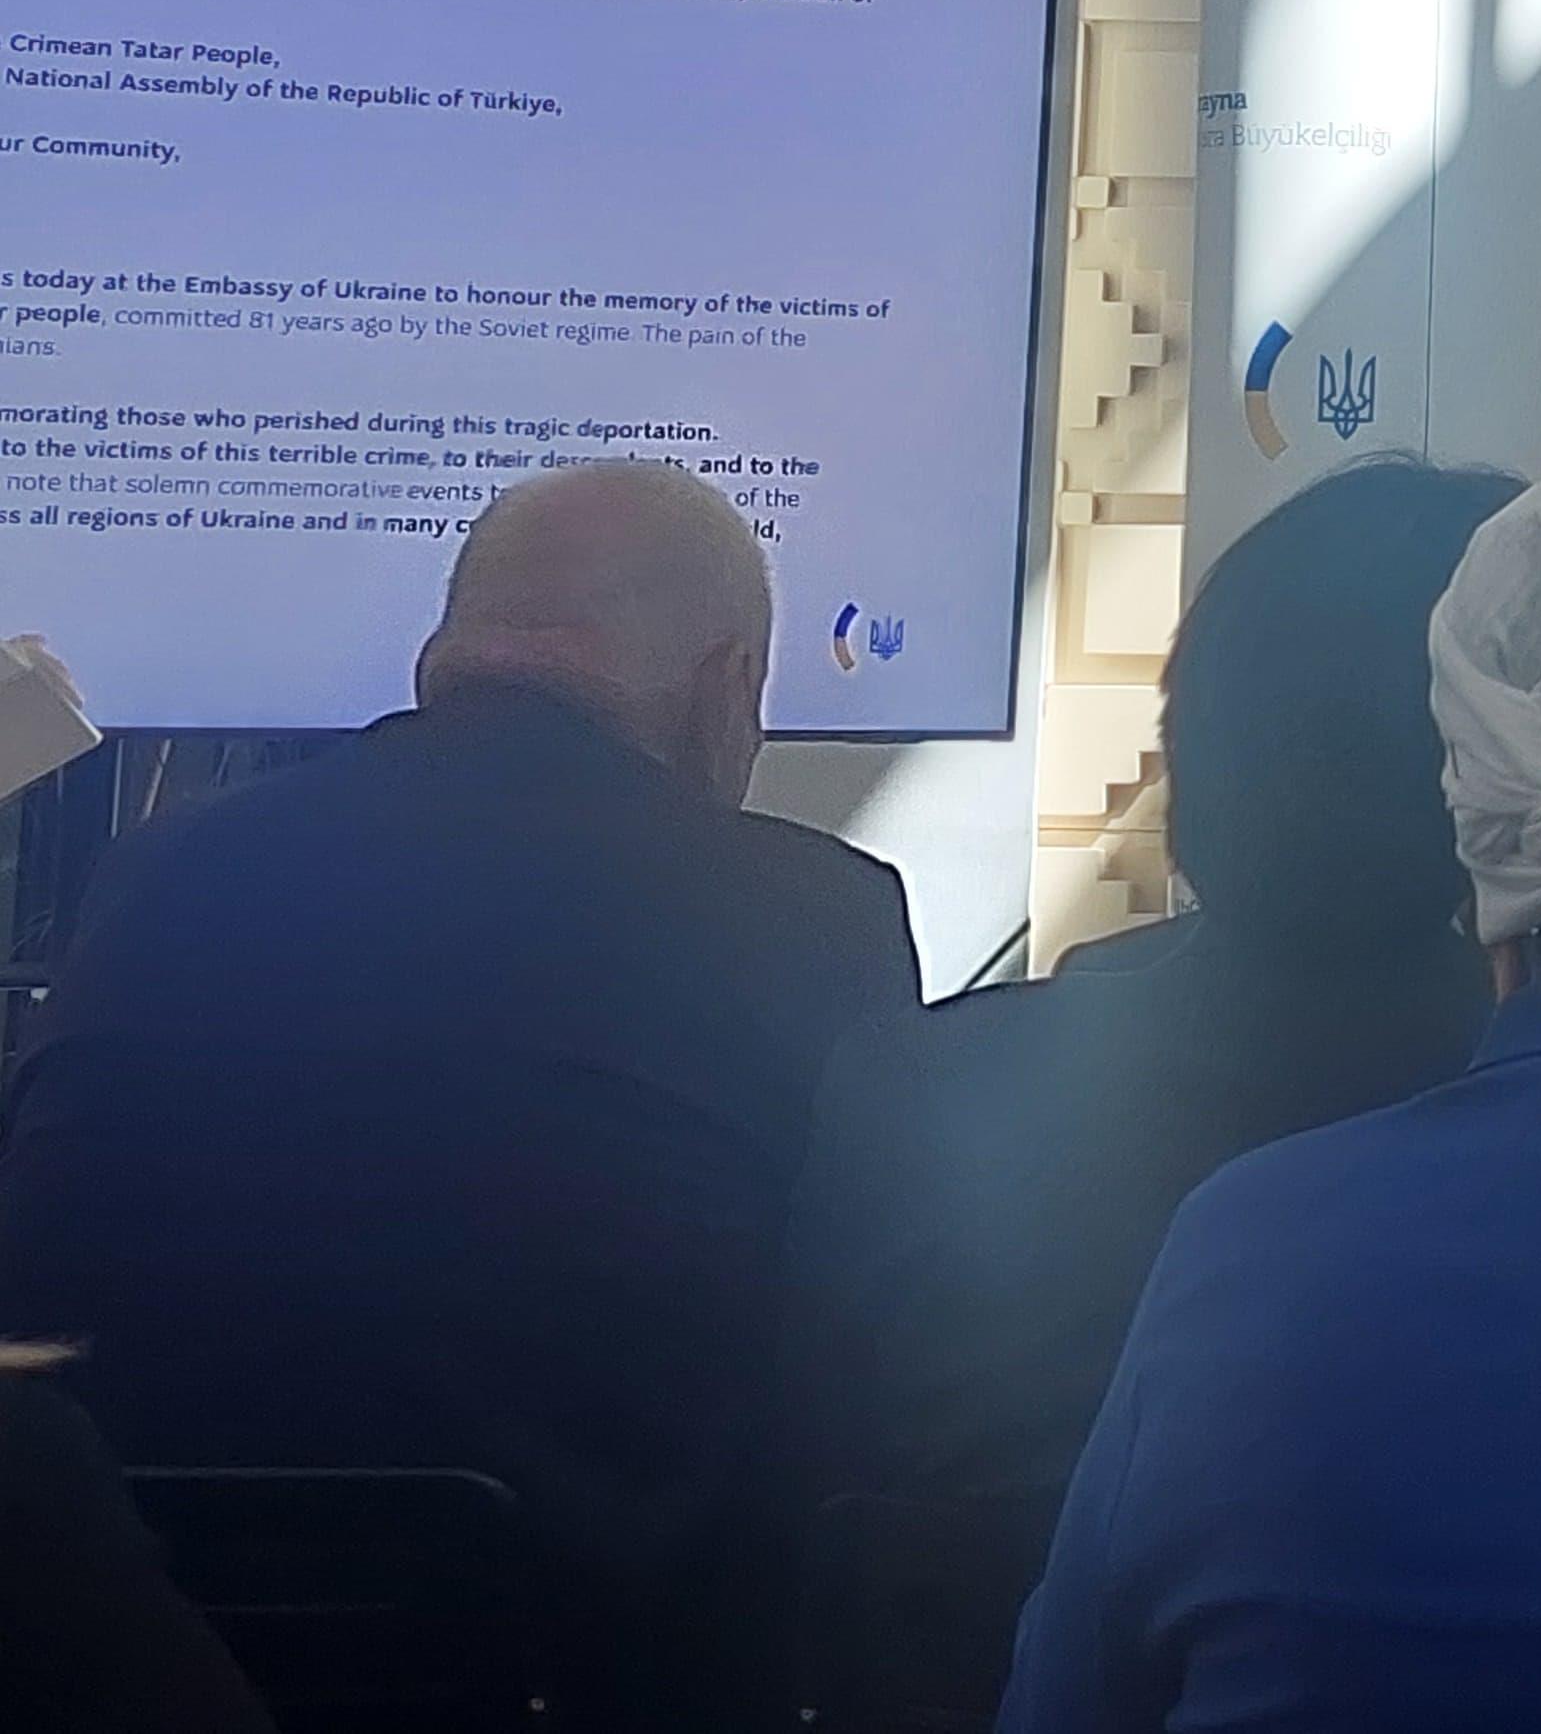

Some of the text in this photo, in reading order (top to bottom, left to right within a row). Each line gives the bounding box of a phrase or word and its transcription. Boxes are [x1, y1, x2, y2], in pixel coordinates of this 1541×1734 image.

[10, 34, 281, 69] Crimean Tatar People,
[5, 67, 563, 116] National Assembly of the Republic of Türkiye,
[32, 136, 181, 165] Community,
[23, 269, 95, 295] today
[102, 274, 129, 292] at
[136, 273, 177, 294] the
[184, 276, 293, 303] Embassy
[300, 279, 329, 298] of
[335, 280, 427, 303] Ukraine
[435, 286, 459, 304] to
[467, 282, 553, 307] honour
[559, 288, 597, 309] the
[604, 294, 698, 317] memory
[704, 294, 731, 314] of
[736, 296, 773, 316] the
[780, 298, 859, 319] victims
[866, 299, 891, 319] of
[15, 303, 107, 330] people,
[115, 306, 241, 329] committed
[249, 312, 275, 331] 81
[282, 315, 345, 336] years
[351, 317, 393, 339] ago
[400, 315, 429, 341] by
[435, 316, 472, 337] the
[479, 318, 549, 340] Soviet
[642, 324, 682, 344] The
[688, 328, 735, 350] pain
[742, 327, 767, 347] of
[771, 328, 807, 348] the
[117, 406, 186, 428] those
[194, 409, 247, 430] who
[253, 411, 360, 436] perished
[367, 414, 446, 439] during
[453, 416, 498, 437] this
[504, 419, 570, 443] tragic
[577, 418, 720, 445] deportation.
[2, 437, 27, 457] to
[35, 436, 77, 458] the
[84, 438, 173, 462] victims
[180, 441, 209, 462] of
[214, 441, 261, 464] this
[268, 444, 358, 467] terrible
[364, 446, 437, 470] crime,
[443, 450, 468, 469] to
[475, 450, 534, 470] their
[699, 453, 743, 474] and
[750, 456, 775, 475] to
[781, 456, 821, 476] the
[7, 472, 62, 493] note
[69, 472, 118, 496] that
[125, 474, 210, 497] solemn
[217, 478, 402, 502] commemorative
[406, 483, 484, 502] events
[735, 487, 760, 507] of
[765, 487, 800, 508] the
[30, 504, 59, 526] all
[67, 509, 159, 534] regions
[166, 508, 195, 529] of
[200, 510, 296, 532] Ukraine
[302, 511, 348, 533] and
[355, 513, 377, 534] in
[383, 518, 449, 540] many
